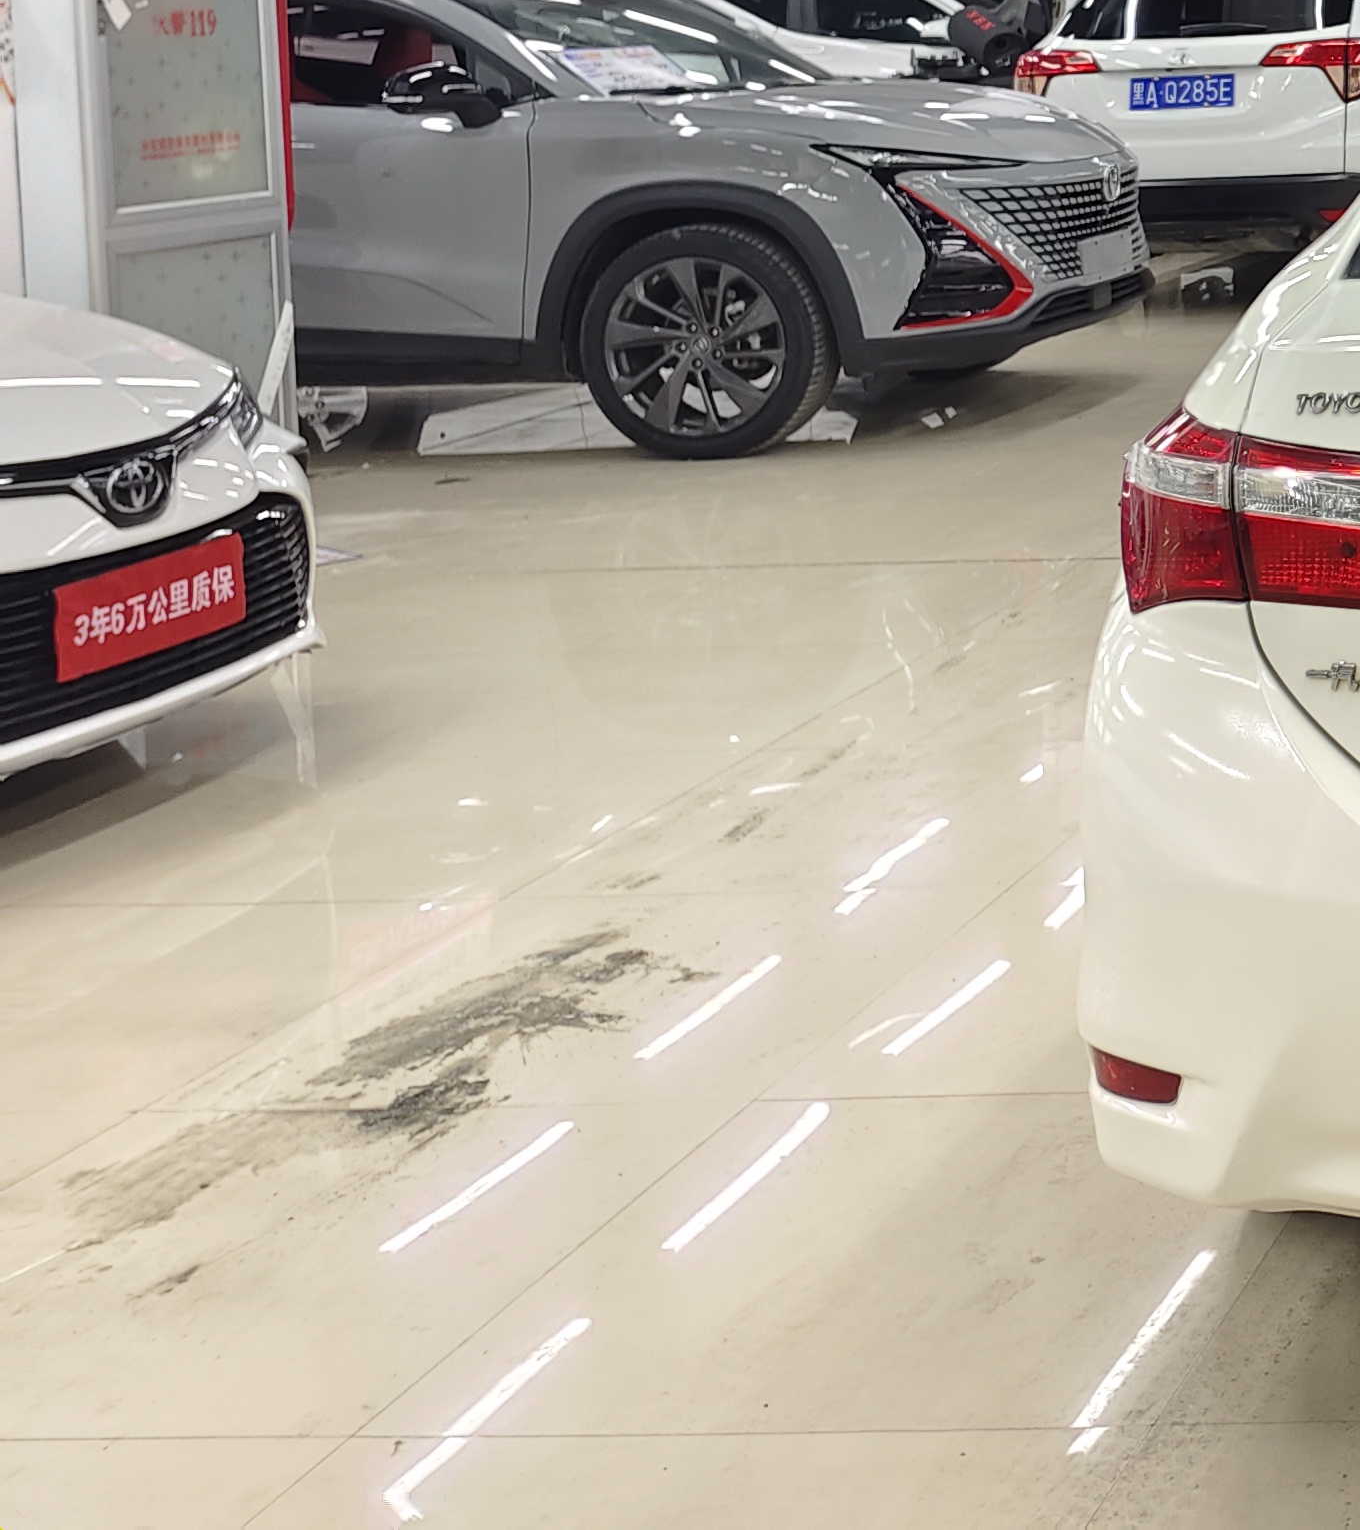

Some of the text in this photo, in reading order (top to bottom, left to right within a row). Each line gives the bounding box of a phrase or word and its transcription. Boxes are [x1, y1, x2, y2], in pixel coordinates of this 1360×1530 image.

[73, 564, 236, 648] 3年6万公里质保
